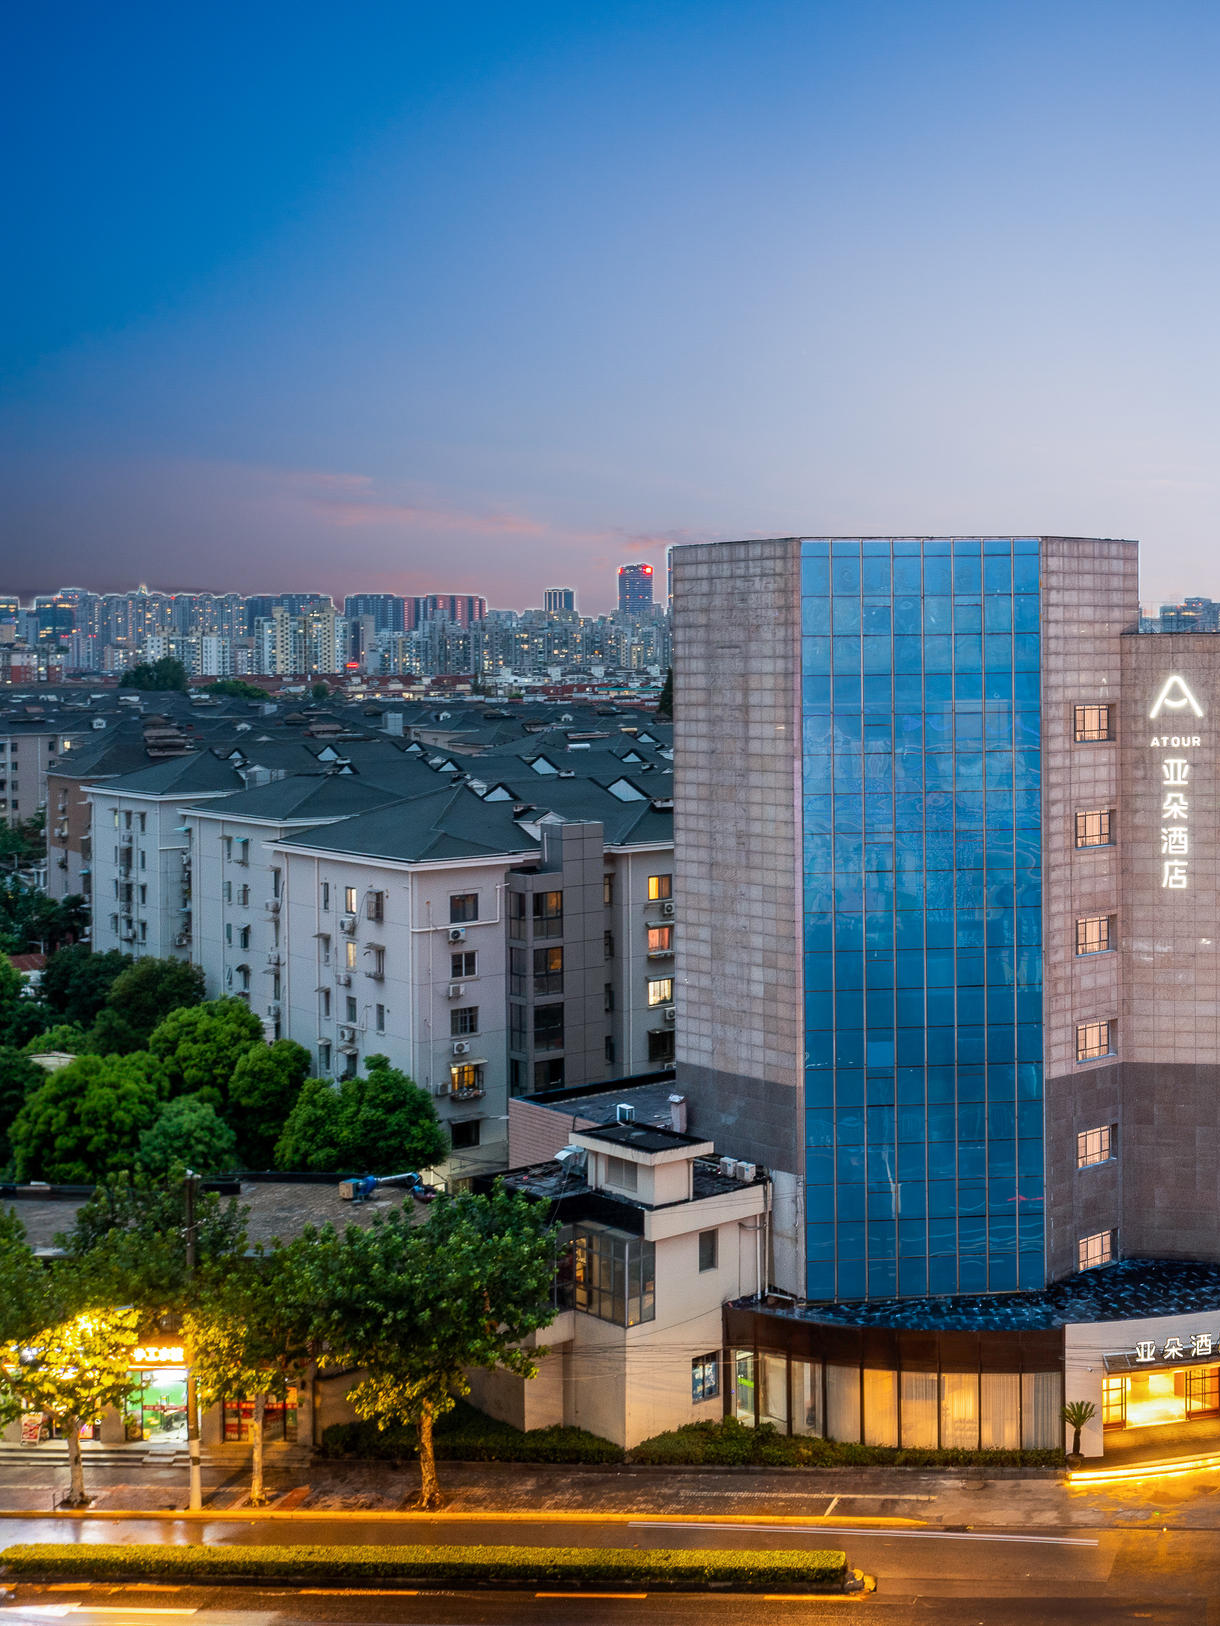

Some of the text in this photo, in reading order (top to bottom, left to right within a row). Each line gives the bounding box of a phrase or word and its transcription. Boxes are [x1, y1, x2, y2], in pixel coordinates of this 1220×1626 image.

[1150, 736, 1201, 747] ATOUR
[1161, 758, 1190, 889] 亚朵酒店
